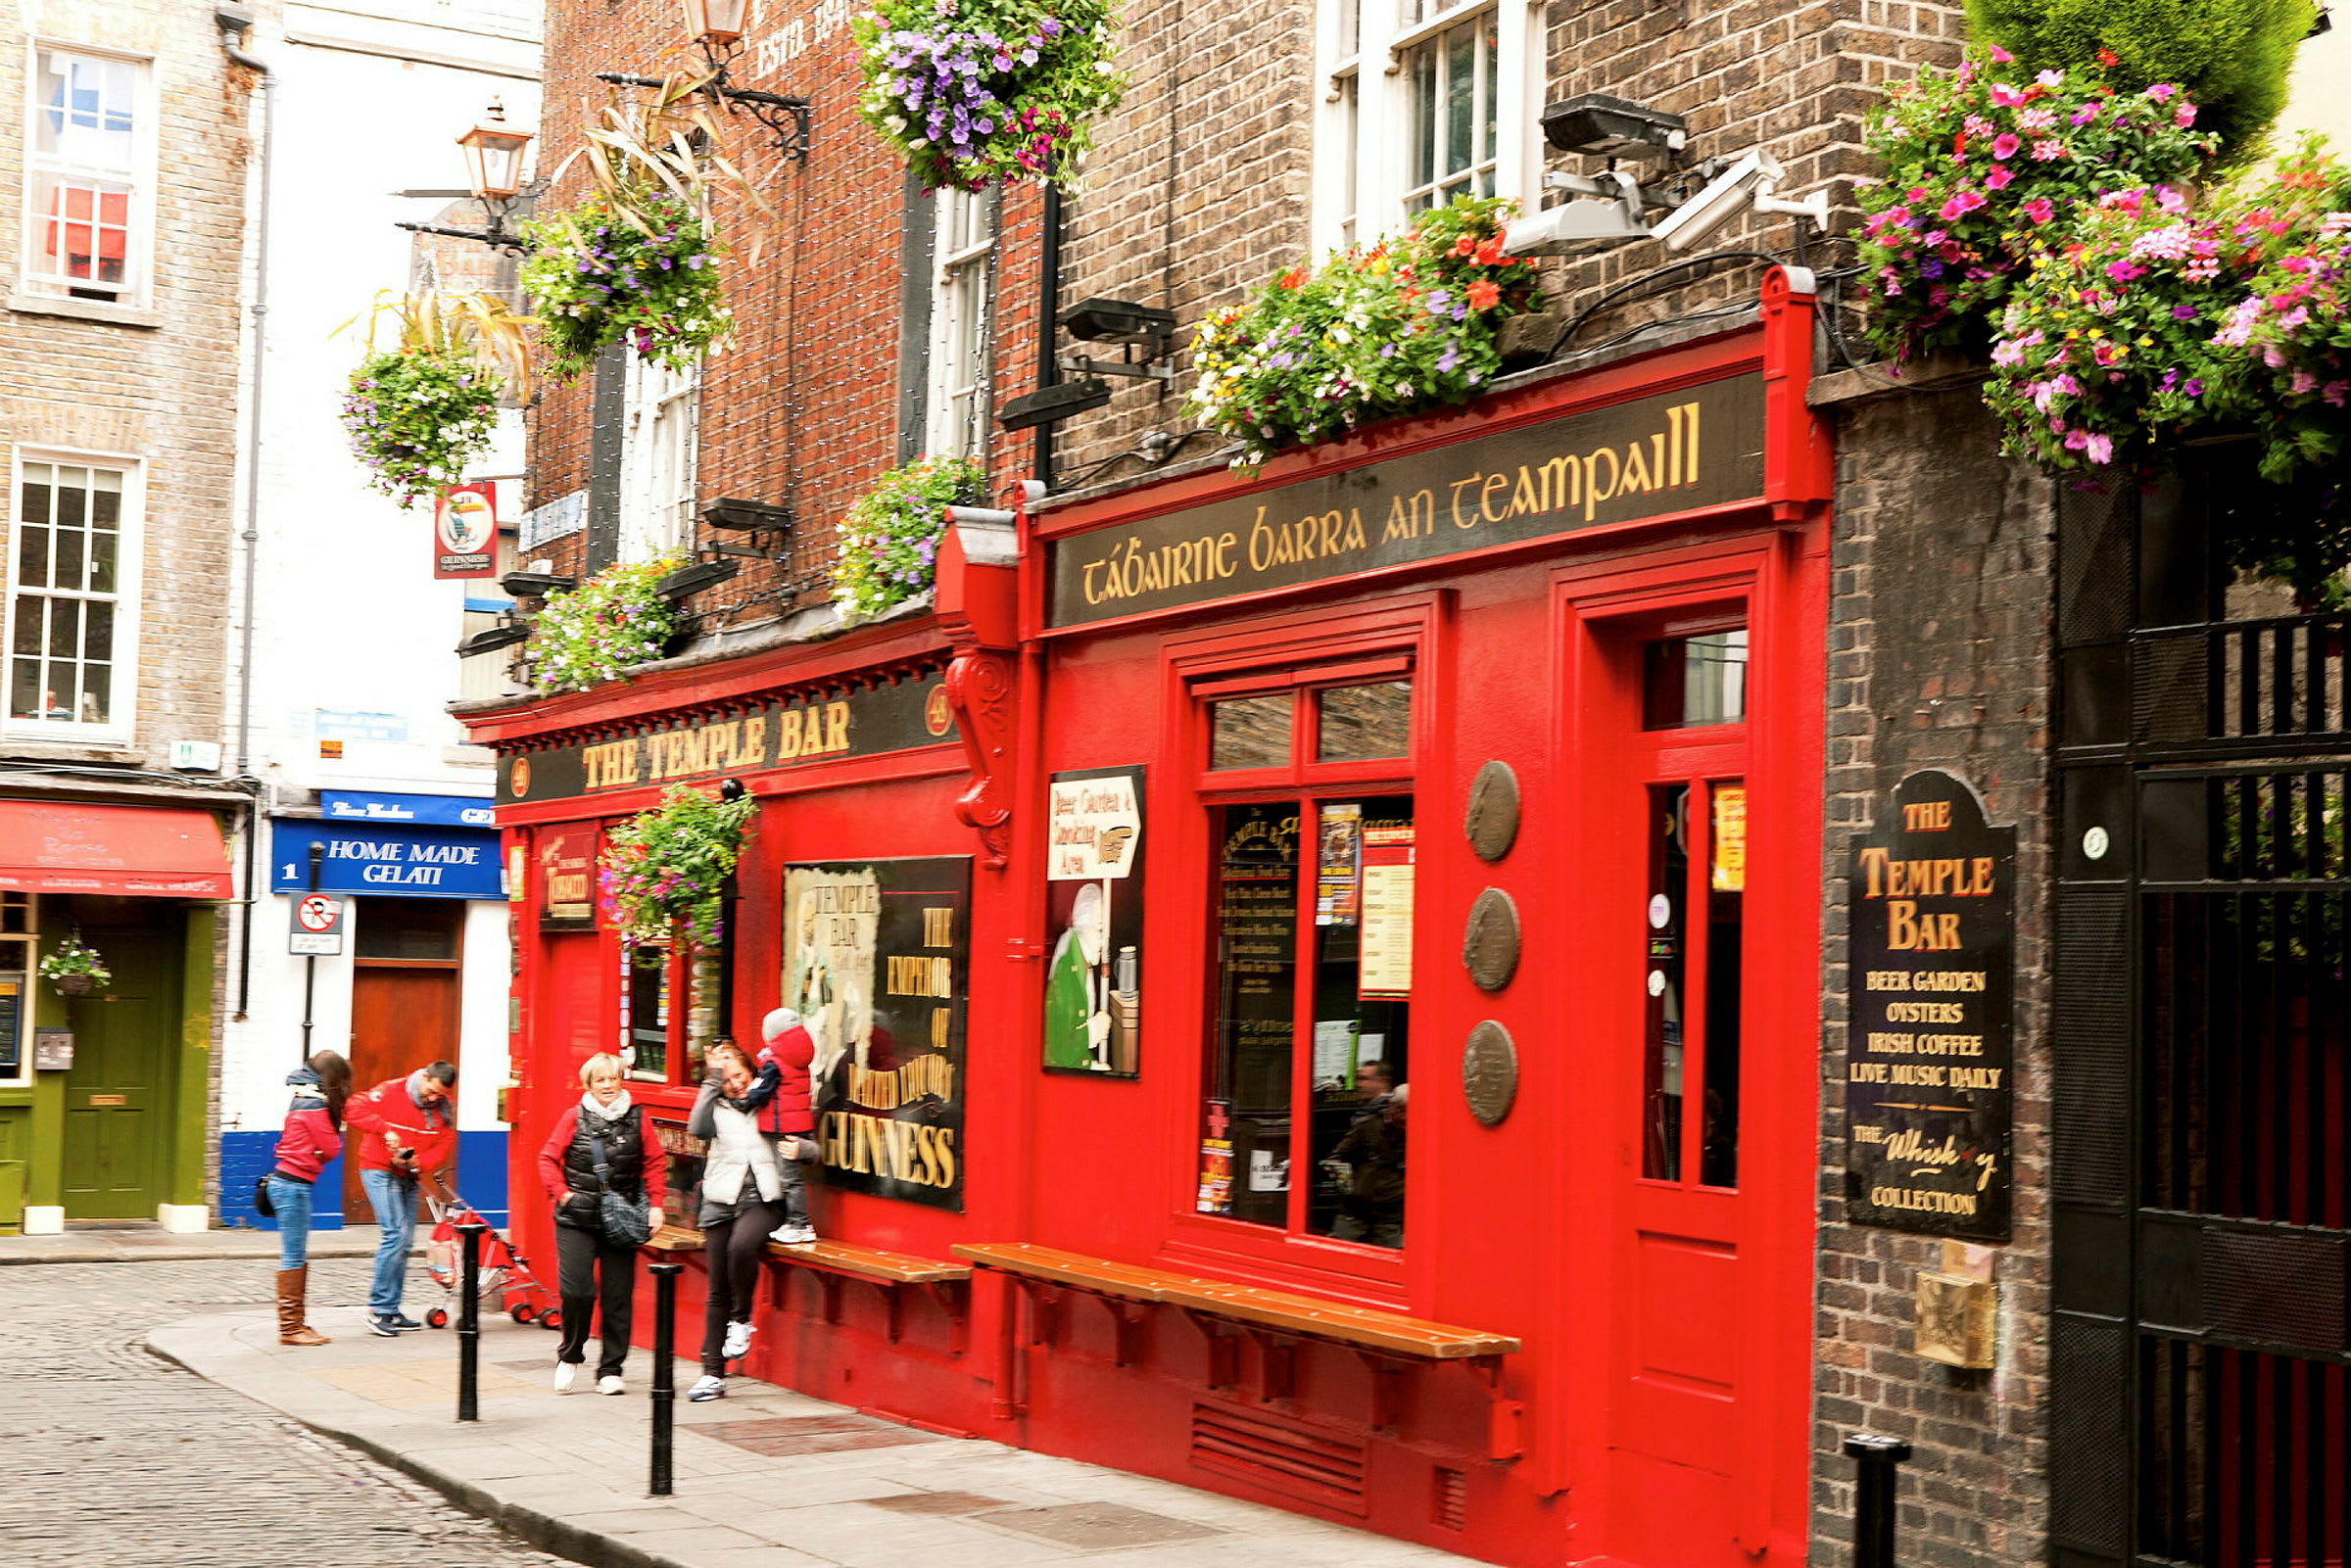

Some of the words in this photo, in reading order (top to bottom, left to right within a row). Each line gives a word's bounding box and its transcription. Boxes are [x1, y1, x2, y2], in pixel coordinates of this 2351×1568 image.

[582, 738, 639, 789] THE
[647, 716, 767, 781] TEMPLE
[777, 700, 851, 761] BAR
[1903, 801, 1952, 832] THE
[327, 840, 404, 862] HOME
[408, 843, 481, 866] MADE
[281, 863, 299, 880] 1
[362, 864, 444, 885] GELATI
[1887, 899, 1962, 952] BAR
[1865, 971, 1910, 992] BEER
[1913, 971, 1986, 993] GARDEN
[1886, 1002, 1964, 1024] OYSTERS
[1867, 1032, 1914, 1054] IRISH
[1916, 1033, 1984, 1057] COFFEE
[1849, 1063, 1889, 1084] LIVE
[1891, 1064, 1946, 1088] MUSIC
[1948, 1066, 2002, 1091] DAILY
[1852, 1124, 1883, 1144] THE
[819, 1111, 956, 1189] GUINNESS
[1871, 1186, 1977, 1215] COLLECTION
